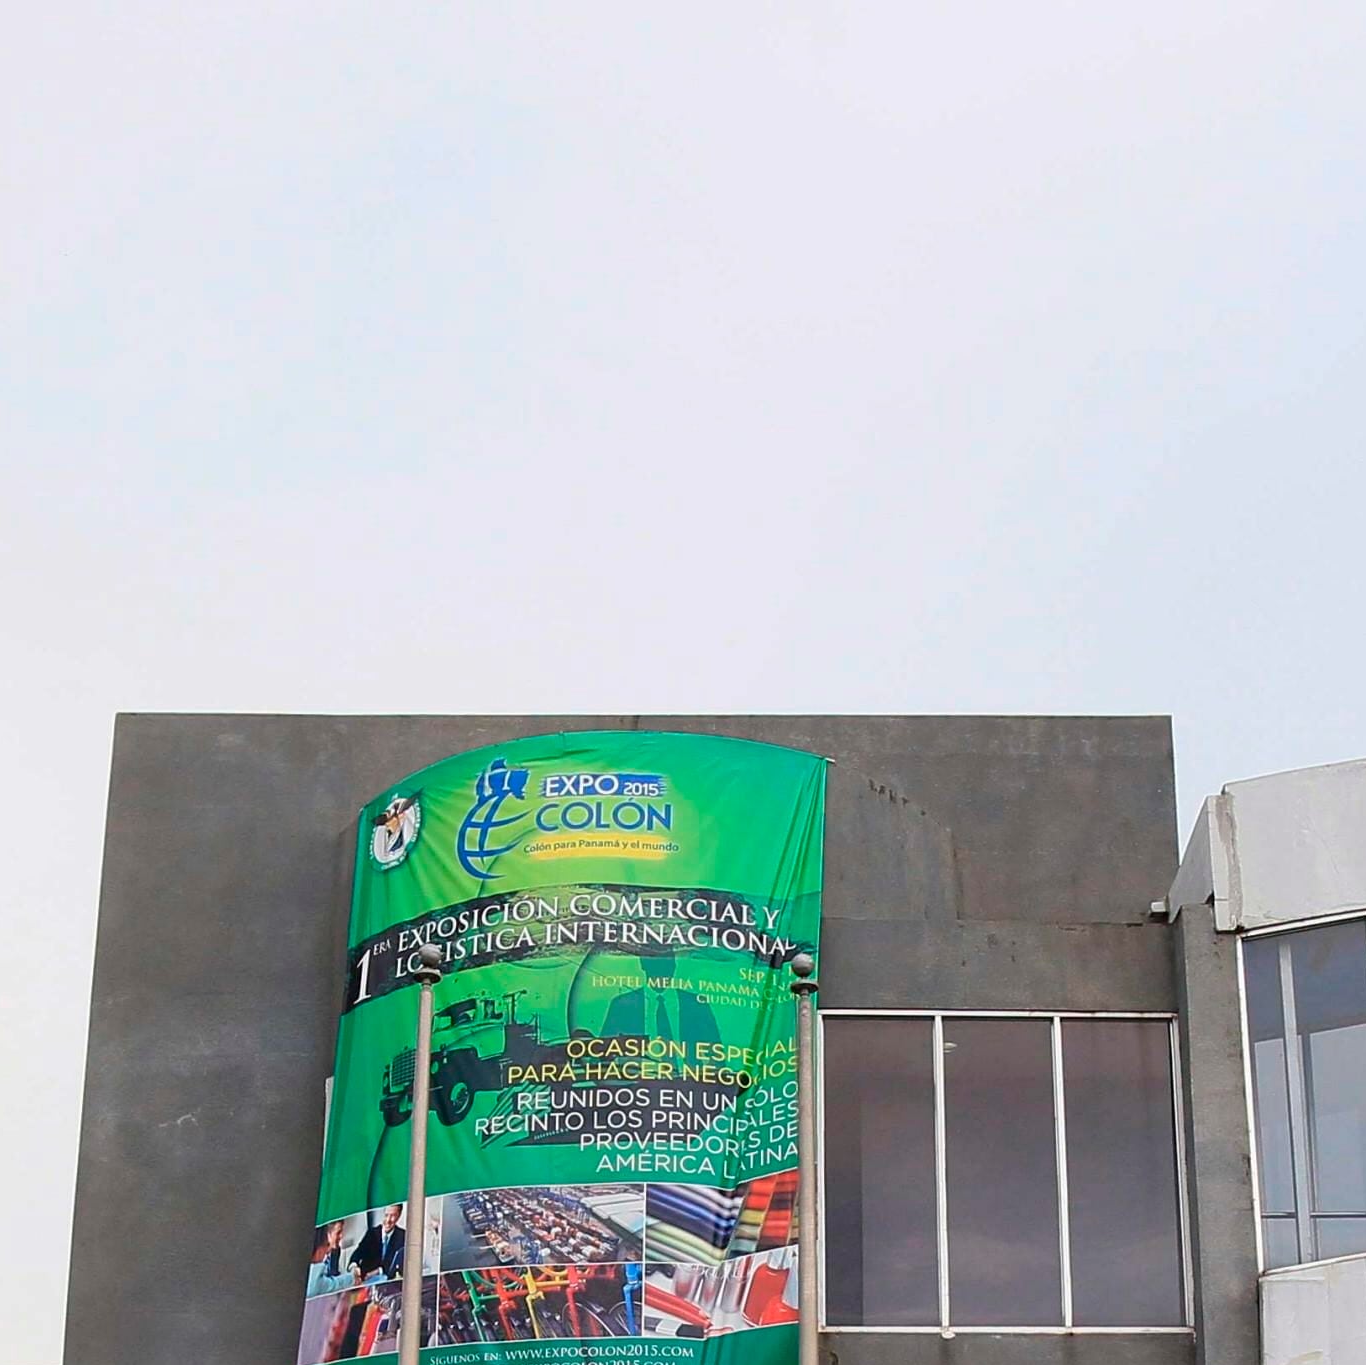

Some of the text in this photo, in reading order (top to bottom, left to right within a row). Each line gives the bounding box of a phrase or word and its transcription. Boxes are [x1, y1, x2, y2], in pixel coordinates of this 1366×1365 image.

[545, 774, 660, 797] EXPO 2015
[534, 795, 672, 833] COLÓN
[523, 838, 680, 855] Colón para Panamá y el mundo
[396, 892, 782, 953] EXPOSICIÓN COMERCIAL Y
[394, 919, 798, 979] LOISTICA INTERNACIONAL
[592, 975, 641, 989] HOTEL
[696, 993, 747, 1008] CIUDAD
[566, 1036, 686, 1059] OCASIÓN
[507, 1064, 576, 1085] PARA
[585, 1061, 673, 1081] HACER
[516, 1080, 799, 1113] REUNIDOS EN UN SÓLO
[474, 1099, 799, 1137] RECINTO LOS PRINCIPALES
[769, 1119, 799, 1143] DE
[595, 1150, 715, 1176] AMÉRICA
[505, 1344, 694, 1360] WWW.EXPOCOLON2015.COM
